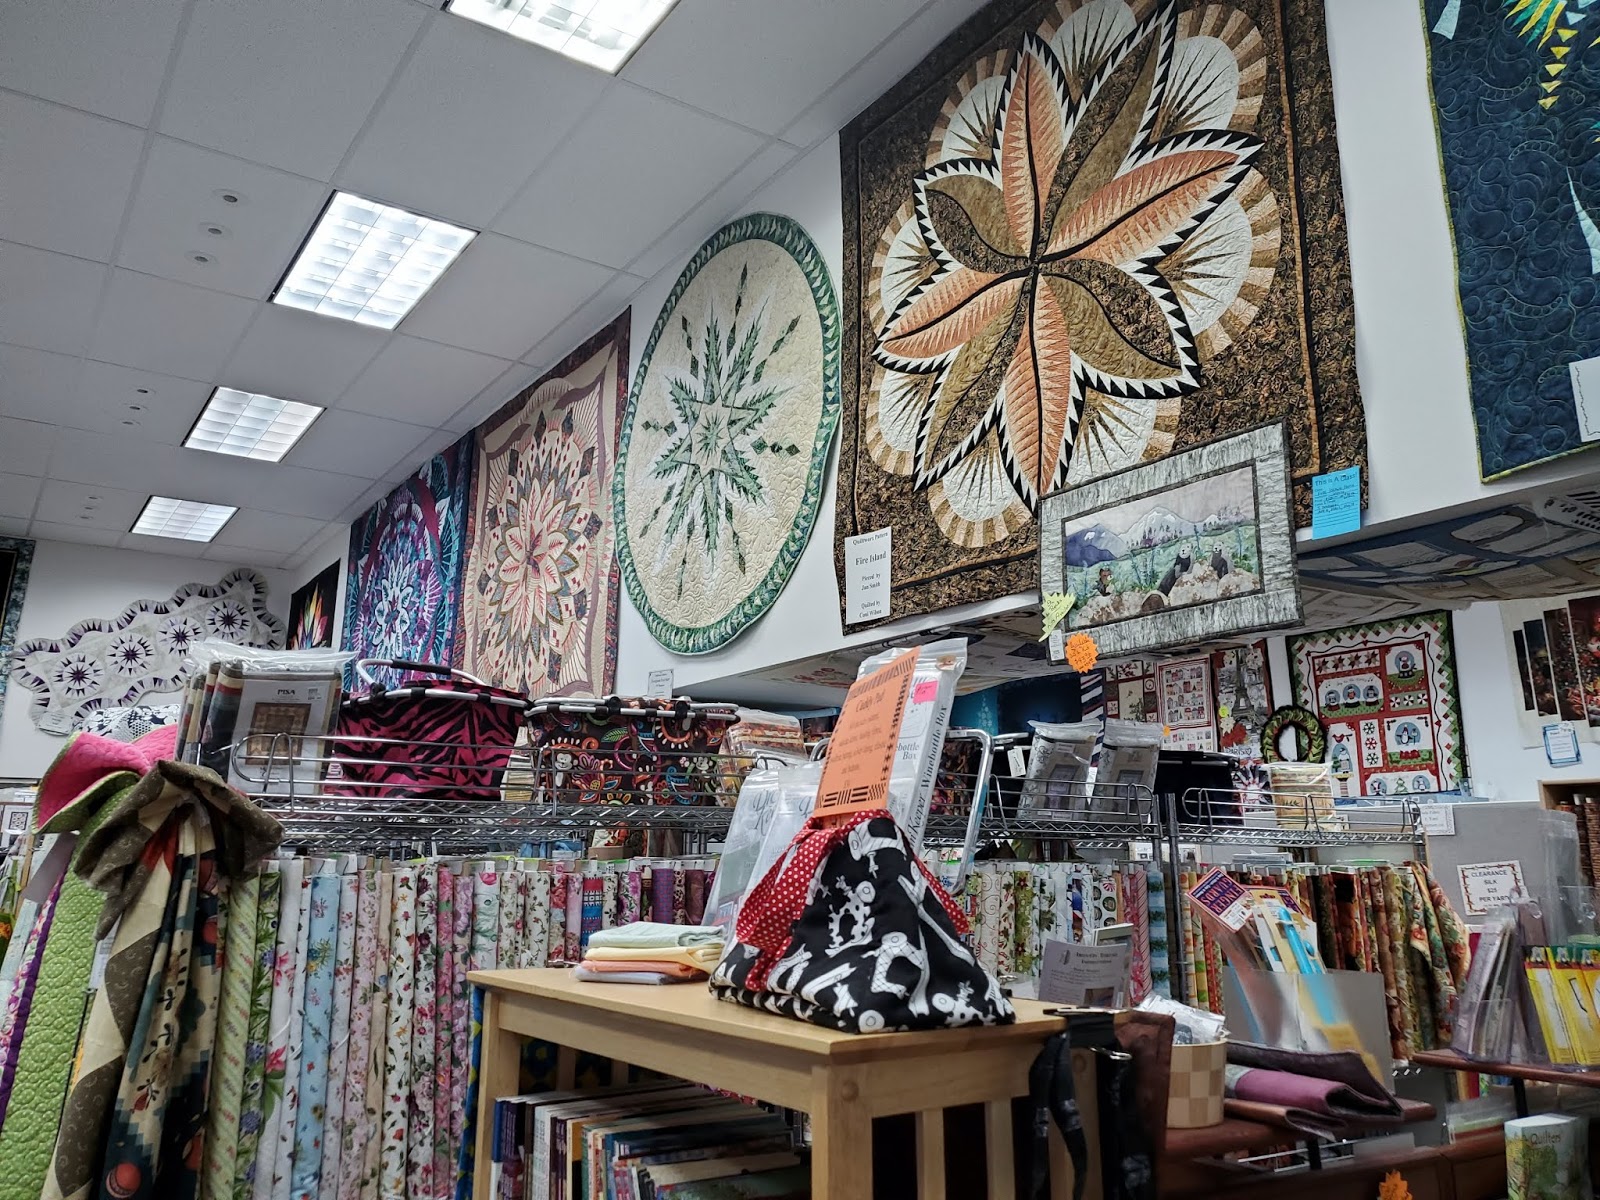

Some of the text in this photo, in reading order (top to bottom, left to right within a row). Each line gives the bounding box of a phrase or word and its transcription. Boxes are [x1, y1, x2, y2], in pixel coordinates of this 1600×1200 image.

[855, 551, 887, 566] Fire Island
[935, 705, 948, 727] Box
[902, 751, 918, 760] Box
[1471, 870, 1508, 878] CLEARANCE
[1200, 877, 1233, 906] GUARDS
[1210, 884, 1244, 913] FINGER
